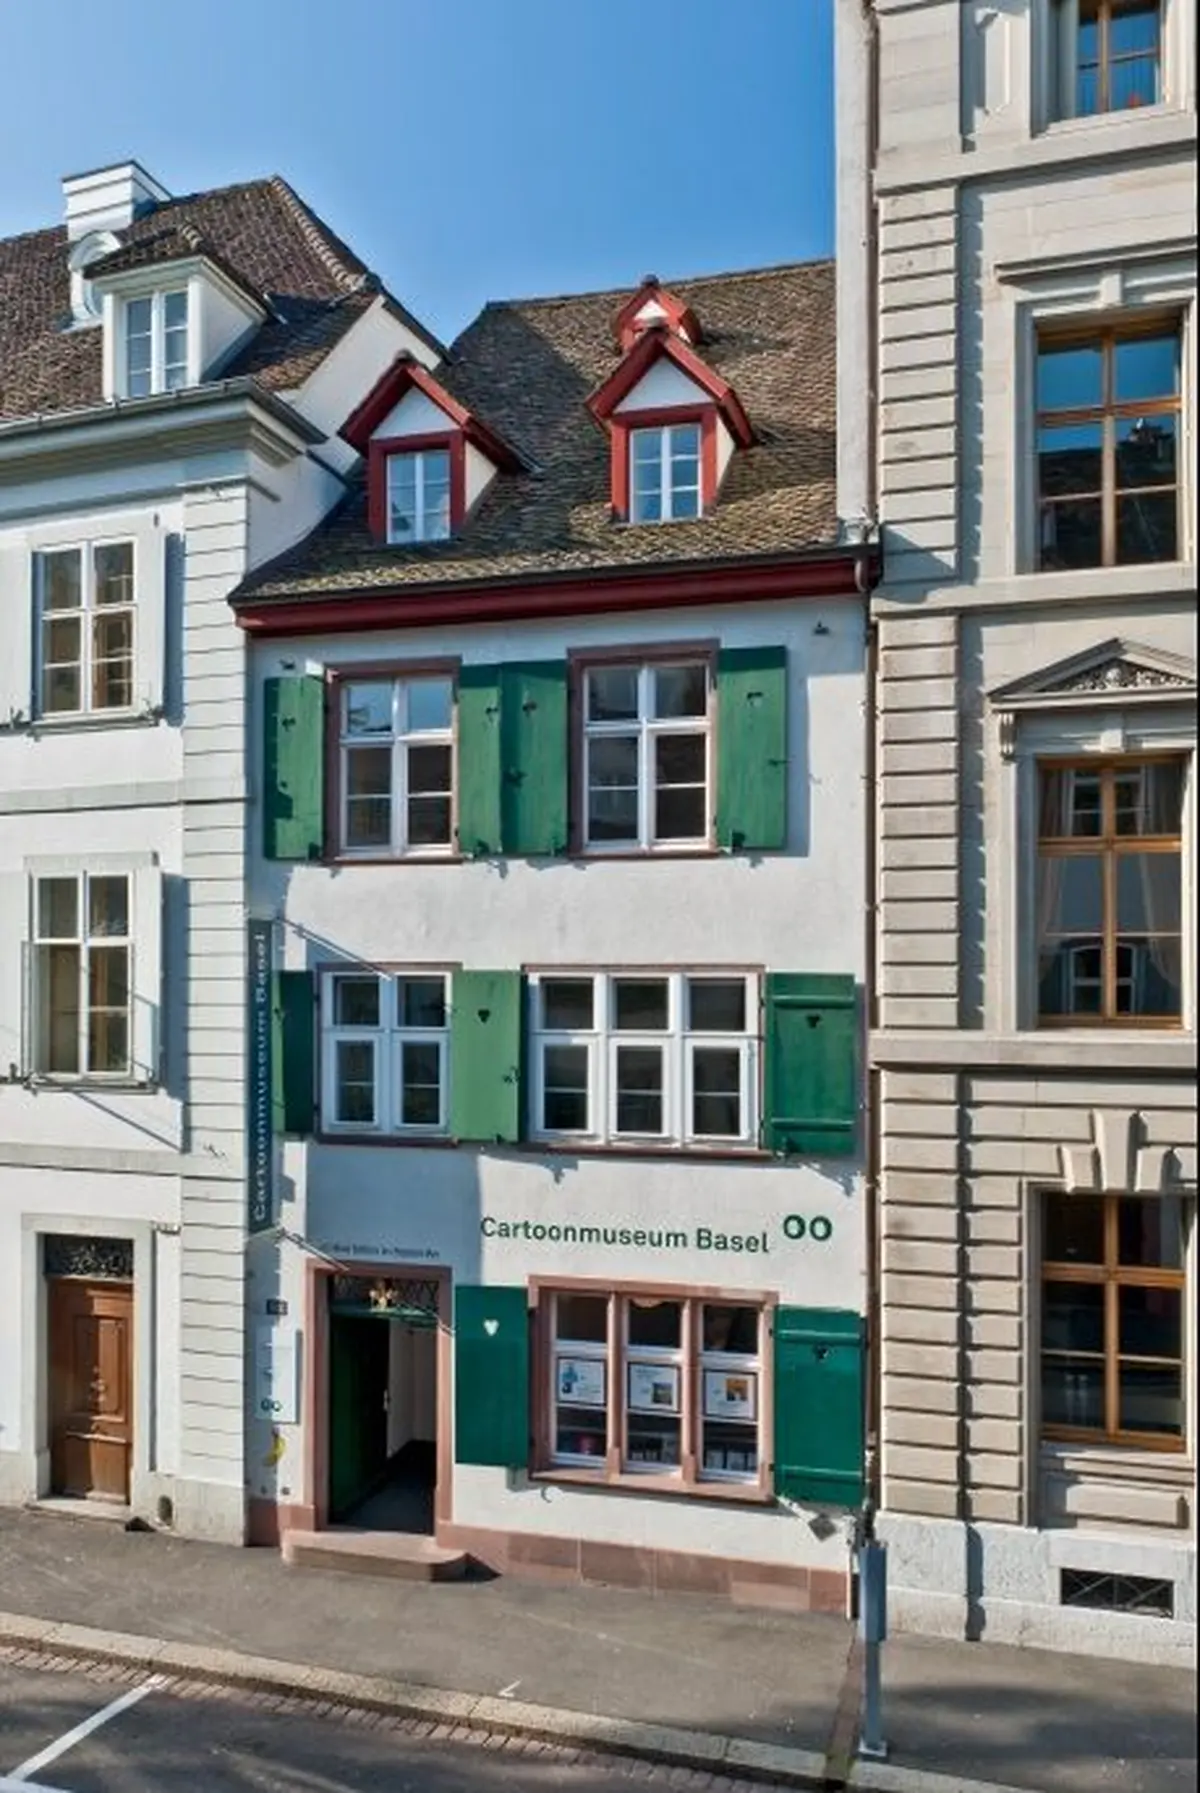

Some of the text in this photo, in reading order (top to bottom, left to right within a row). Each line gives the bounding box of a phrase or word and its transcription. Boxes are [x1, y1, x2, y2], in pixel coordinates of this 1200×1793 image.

[253, 932, 268, 1221] Cartoonmuseum Basel
[480, 1216, 769, 1253] Cartoonmuseum Basel
